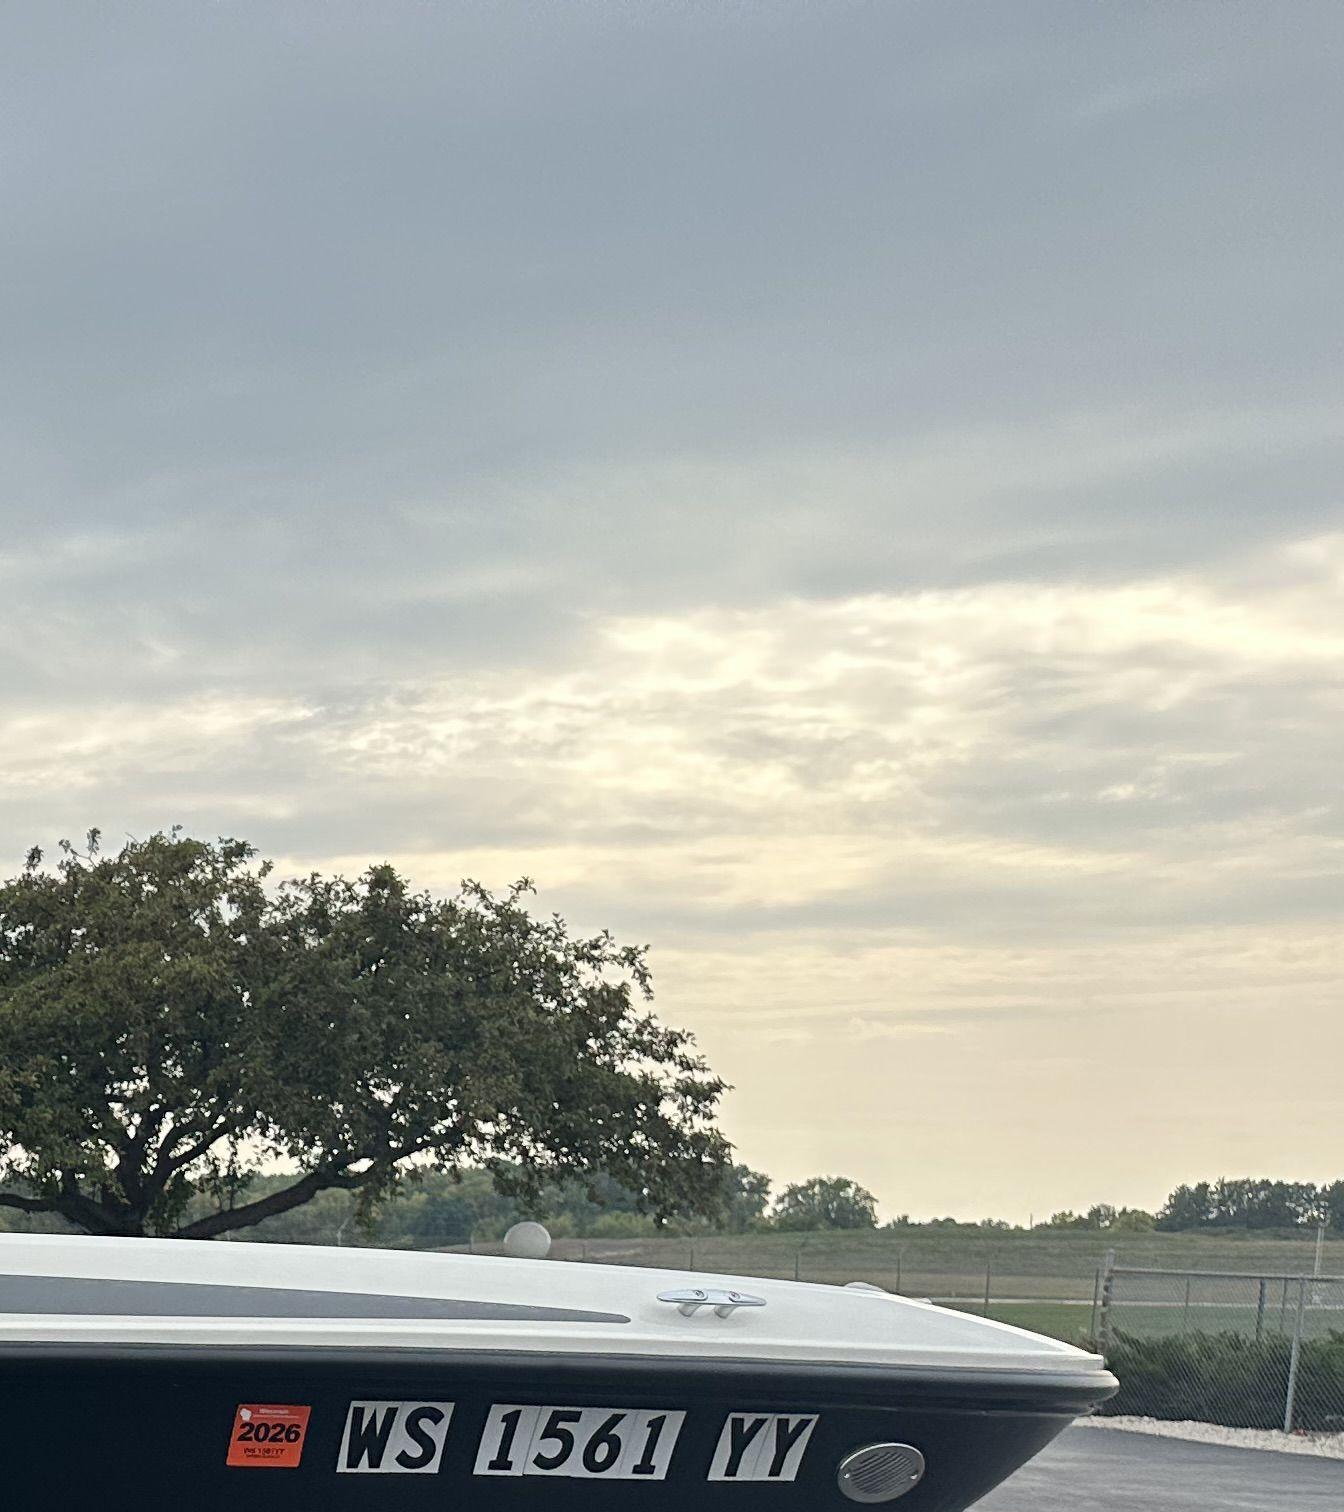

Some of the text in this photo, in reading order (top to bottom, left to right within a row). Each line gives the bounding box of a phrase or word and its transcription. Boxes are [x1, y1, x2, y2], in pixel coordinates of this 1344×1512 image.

[237, 1422, 301, 1443] 2026
[346, 1406, 814, 1477] WS 1561 YY
